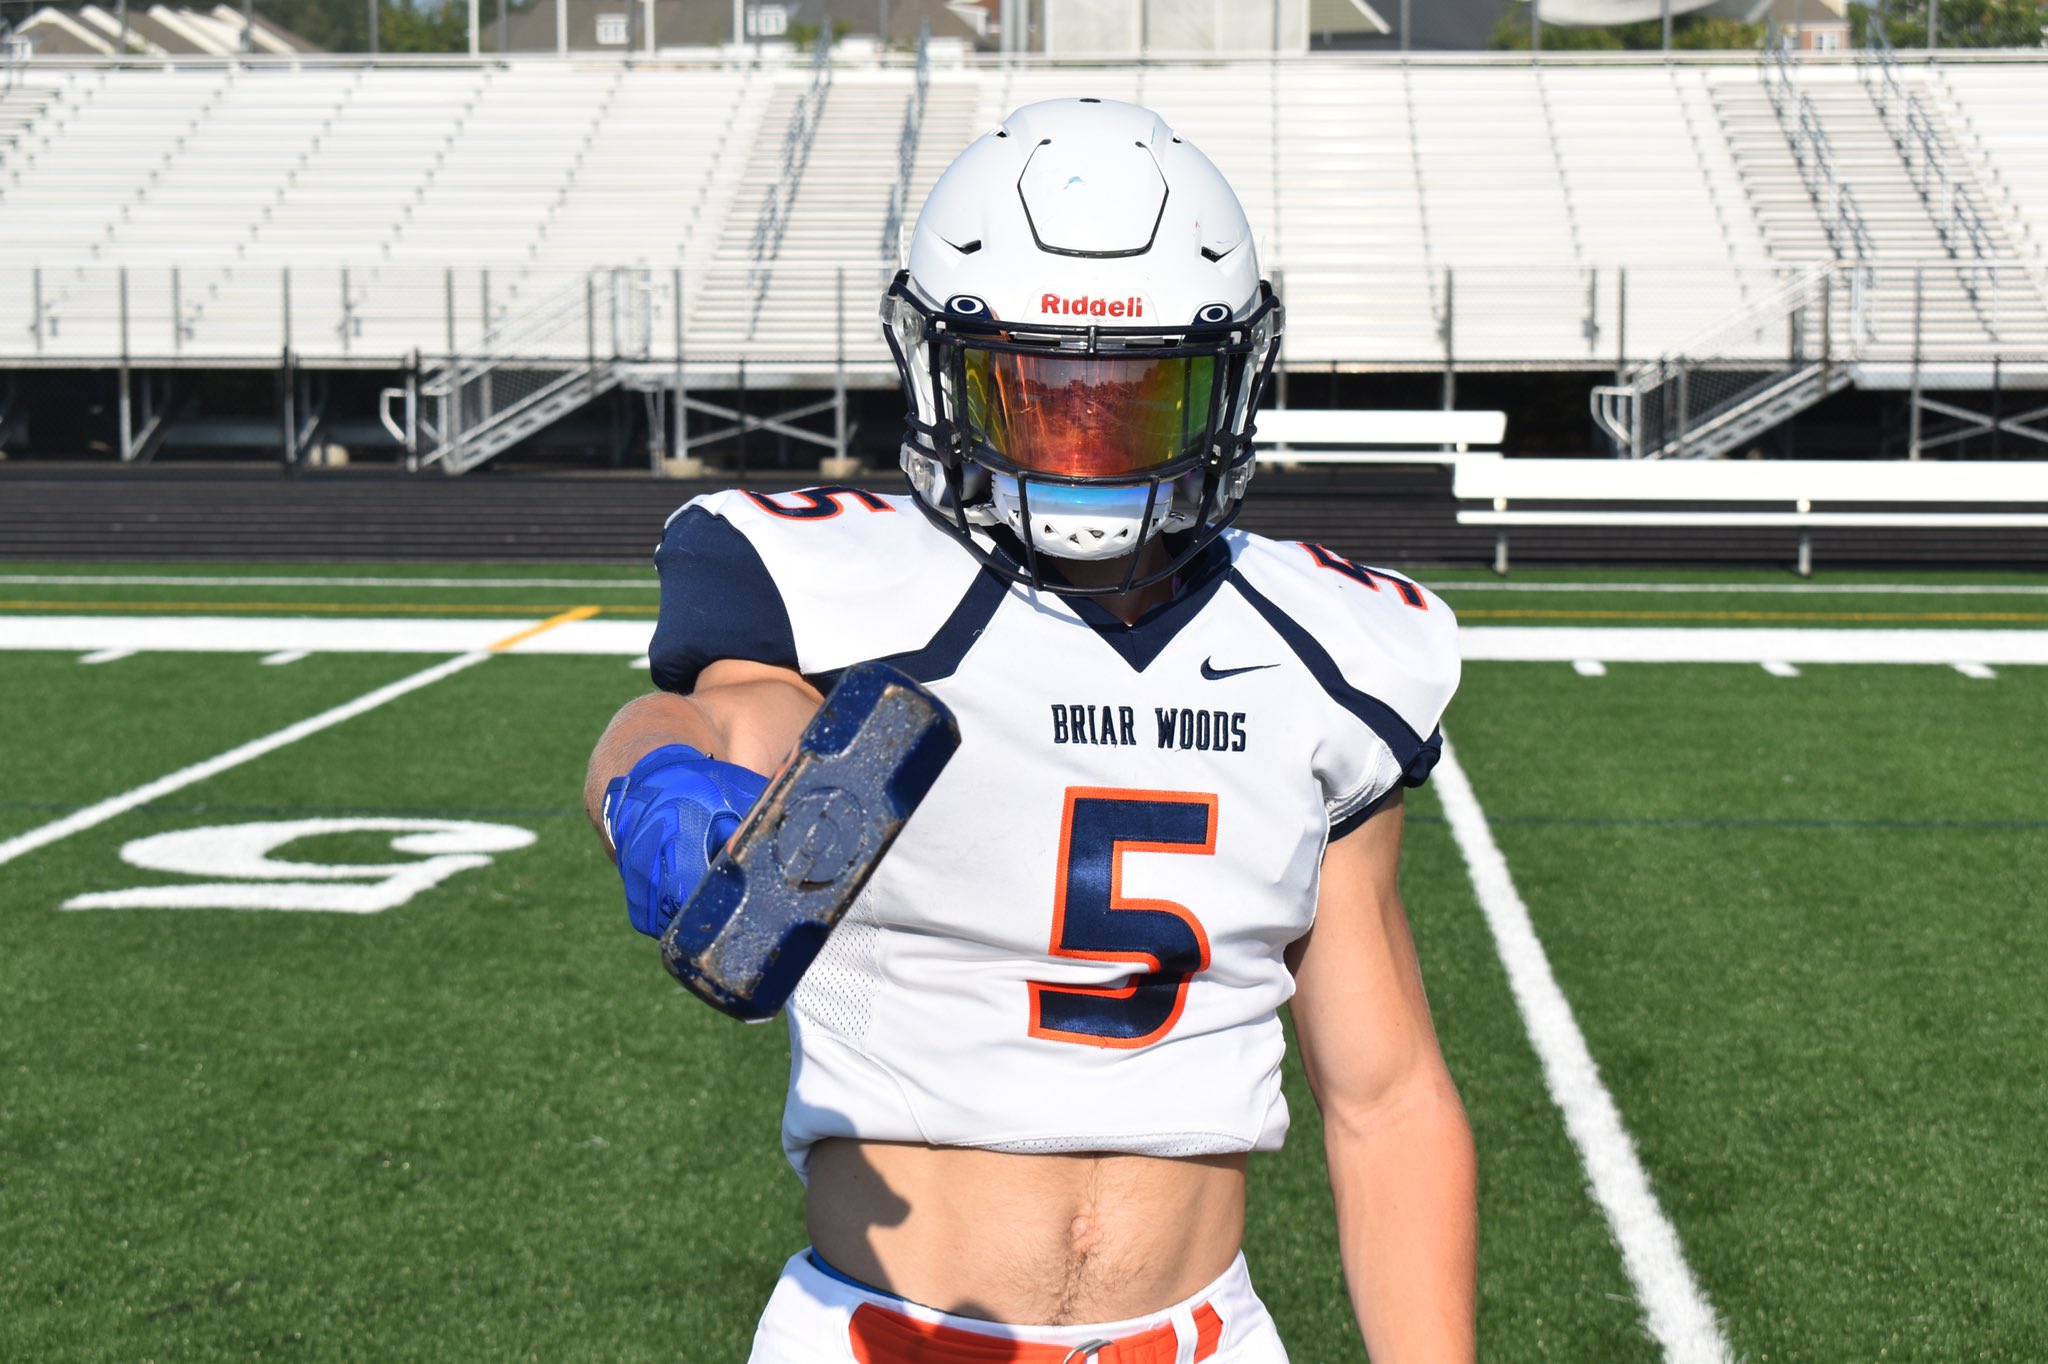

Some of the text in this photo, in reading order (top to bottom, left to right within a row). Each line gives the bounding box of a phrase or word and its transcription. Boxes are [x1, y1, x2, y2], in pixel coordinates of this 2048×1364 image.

[1051, 704, 1246, 752] BRIAR WOODS
[60, 817, 538, 913] 5
[1027, 786, 1218, 1049] 5
